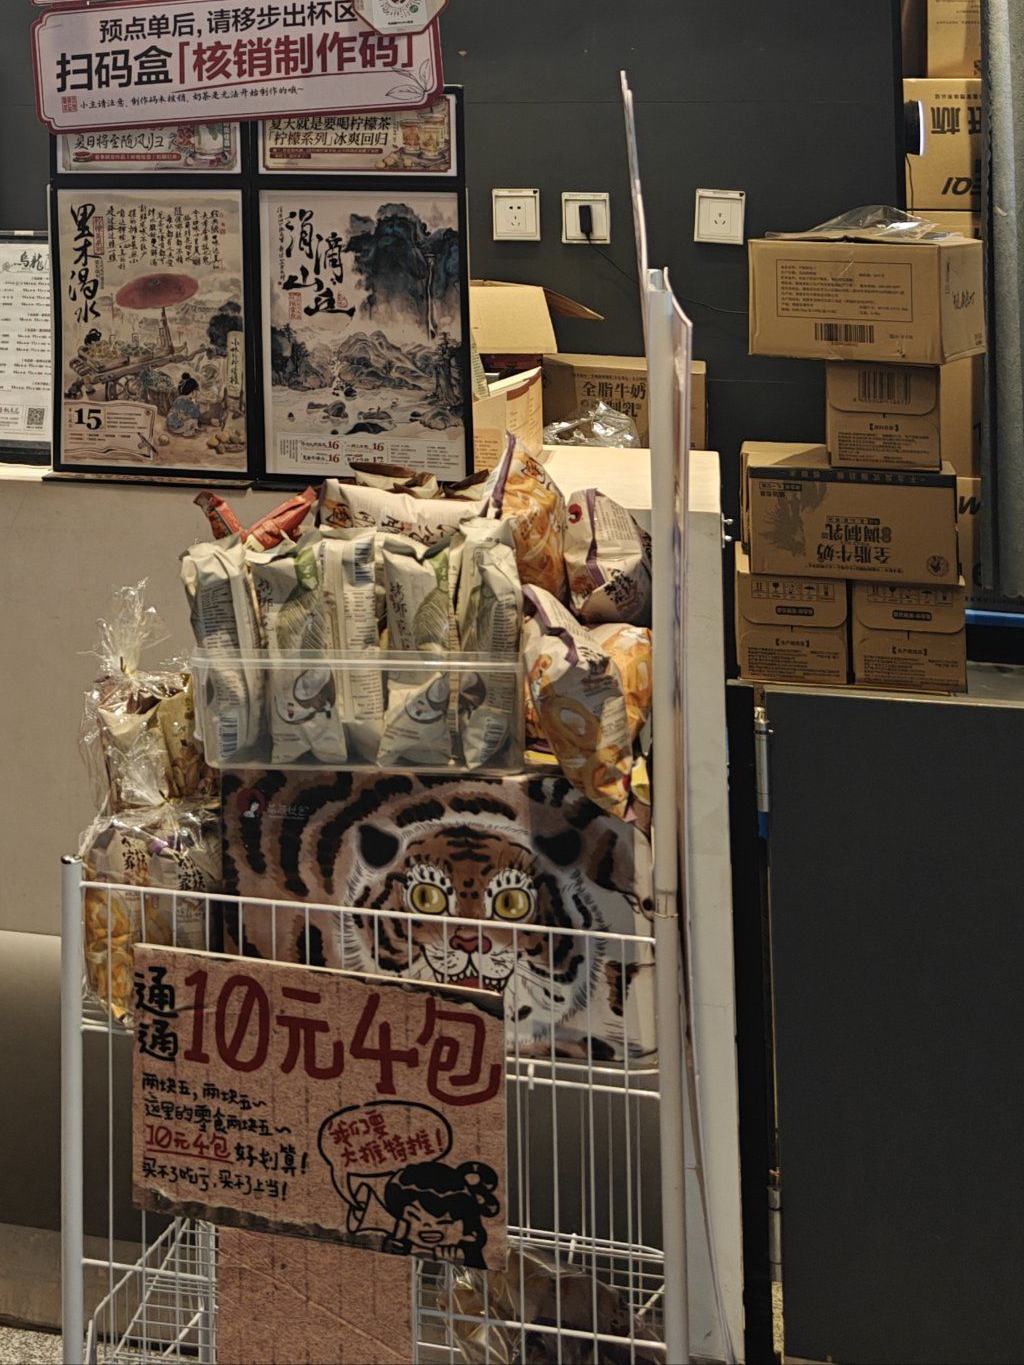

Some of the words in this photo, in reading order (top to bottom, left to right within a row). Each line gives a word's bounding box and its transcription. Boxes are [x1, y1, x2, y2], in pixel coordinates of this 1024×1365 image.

[582, 381, 646, 400] 全脂牛奶
[74, 408, 102, 430] 15
[817, 543, 892, 565] 全脂牛奶
[134, 967, 179, 1062] 通通
[184, 970, 502, 1106] 10元4包
[330, 1111, 385, 1148] 我们要
